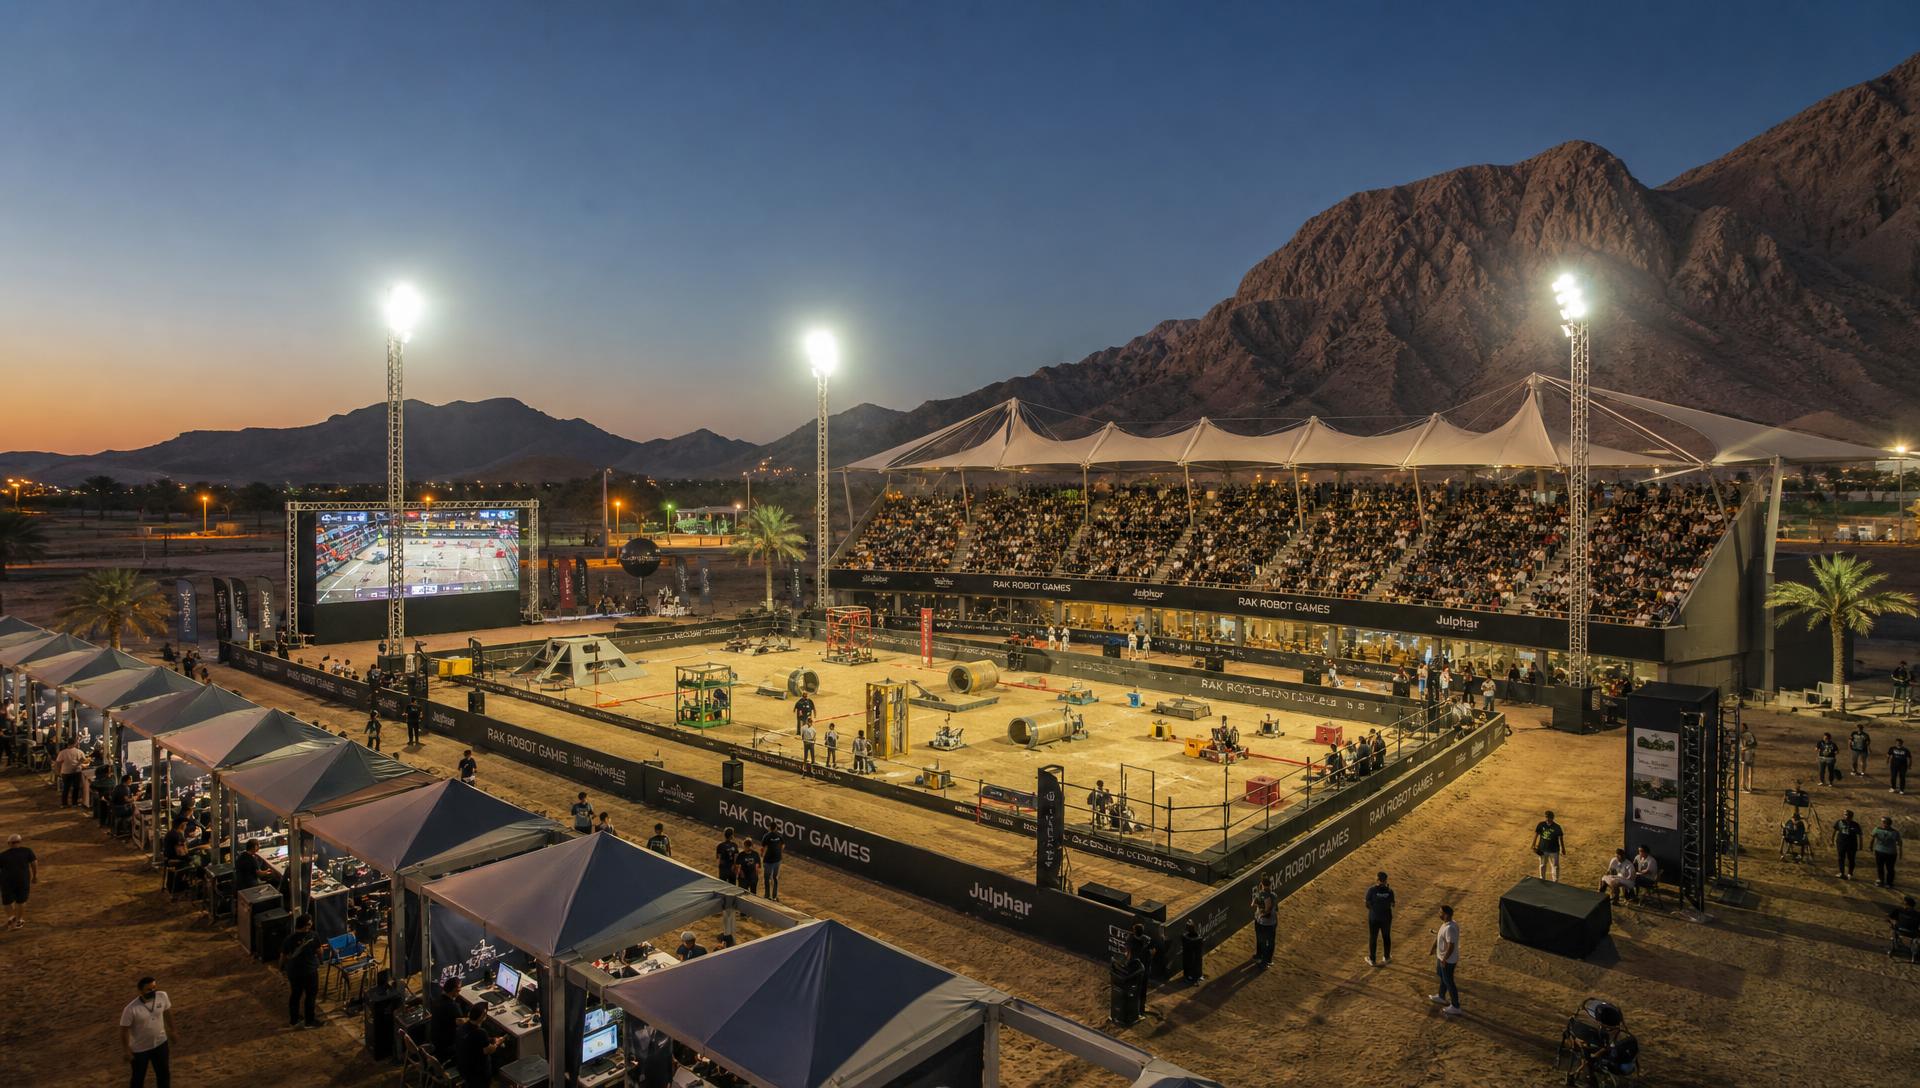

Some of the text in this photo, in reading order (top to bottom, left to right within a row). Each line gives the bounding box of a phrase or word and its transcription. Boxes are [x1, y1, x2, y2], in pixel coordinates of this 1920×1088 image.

[993, 580, 1071, 592] RAK ROBOT GAMES
[1238, 597, 1330, 614] RAK ROBOT GAMES
[1436, 615, 1479, 629] Julphar
[487, 728, 505, 743] RAK
[507, 734, 537, 754] ROBOT
[1369, 802, 1386, 826] RAK
[719, 800, 871, 863] RAK ROBOT GAMES
[1285, 847, 1318, 883] ROBOT
[1318, 827, 1350, 860] GAMES
[969, 882, 1033, 916] Julphar
